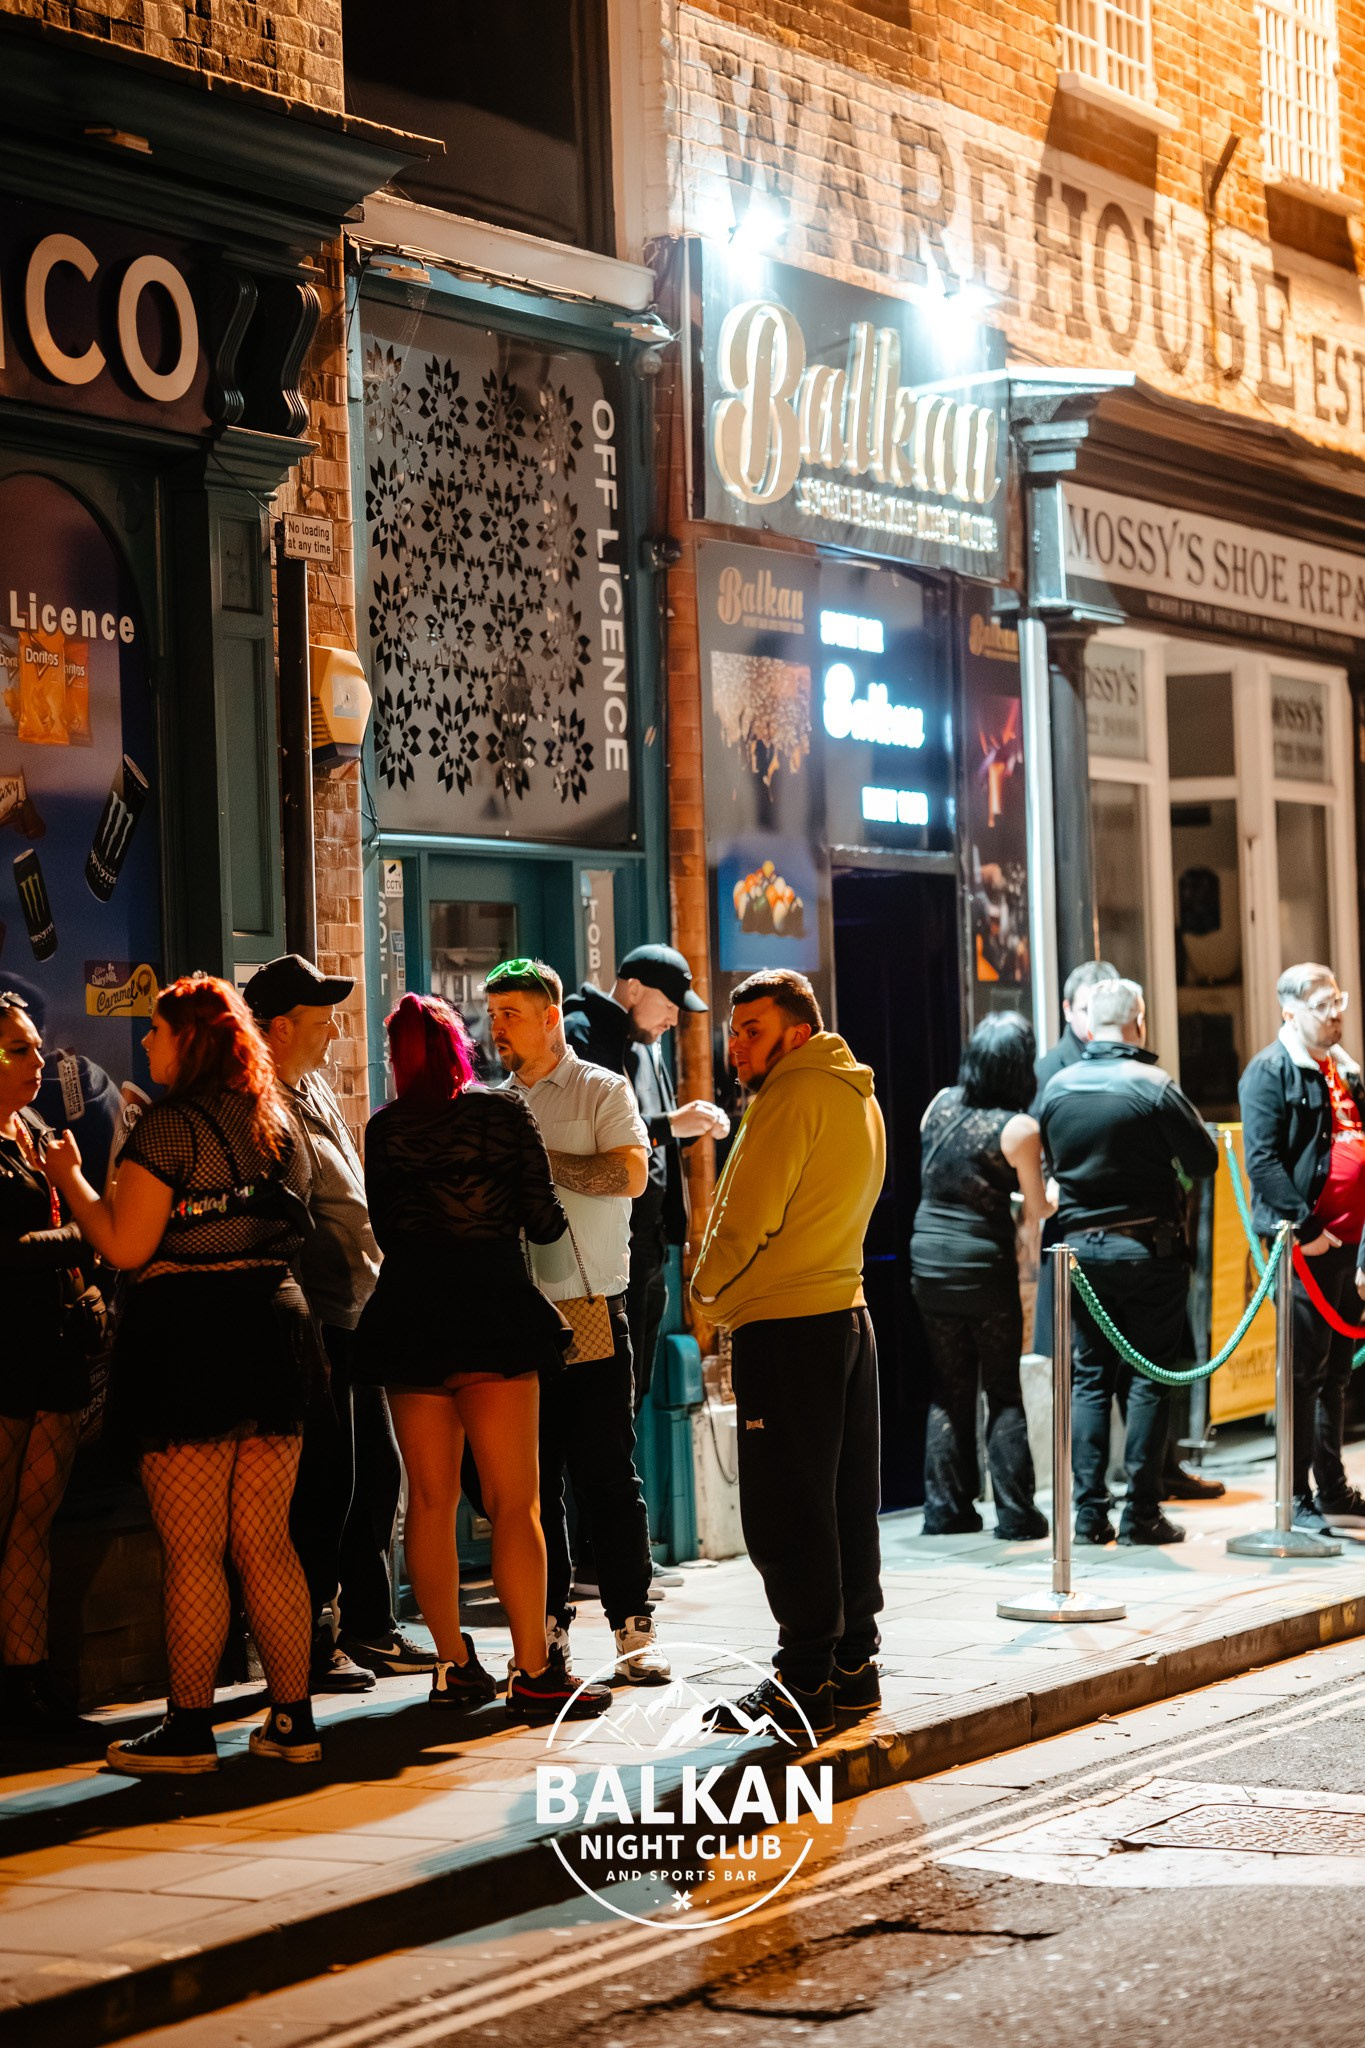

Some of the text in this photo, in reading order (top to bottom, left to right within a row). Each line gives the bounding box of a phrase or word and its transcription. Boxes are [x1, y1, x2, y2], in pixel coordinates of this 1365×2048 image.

[699, 42, 1296, 411] WAREHOUSE
[0, 232, 200, 402] CO
[711, 299, 1001, 506] Balkan
[288, 521, 330, 541] No loading
[288, 537, 331, 555] at any time
[1067, 503, 1206, 586] MOSSY'S
[1213, 538, 1290, 605] SHOE
[591, 398, 629, 772] OFF LICENCE
[717, 566, 804, 626] Balkan
[9, 590, 135, 644] Licence
[25, 647, 59, 667] Doritos
[386, 879, 402, 890] CCTV
[96, 979, 139, 1014] Caramel
